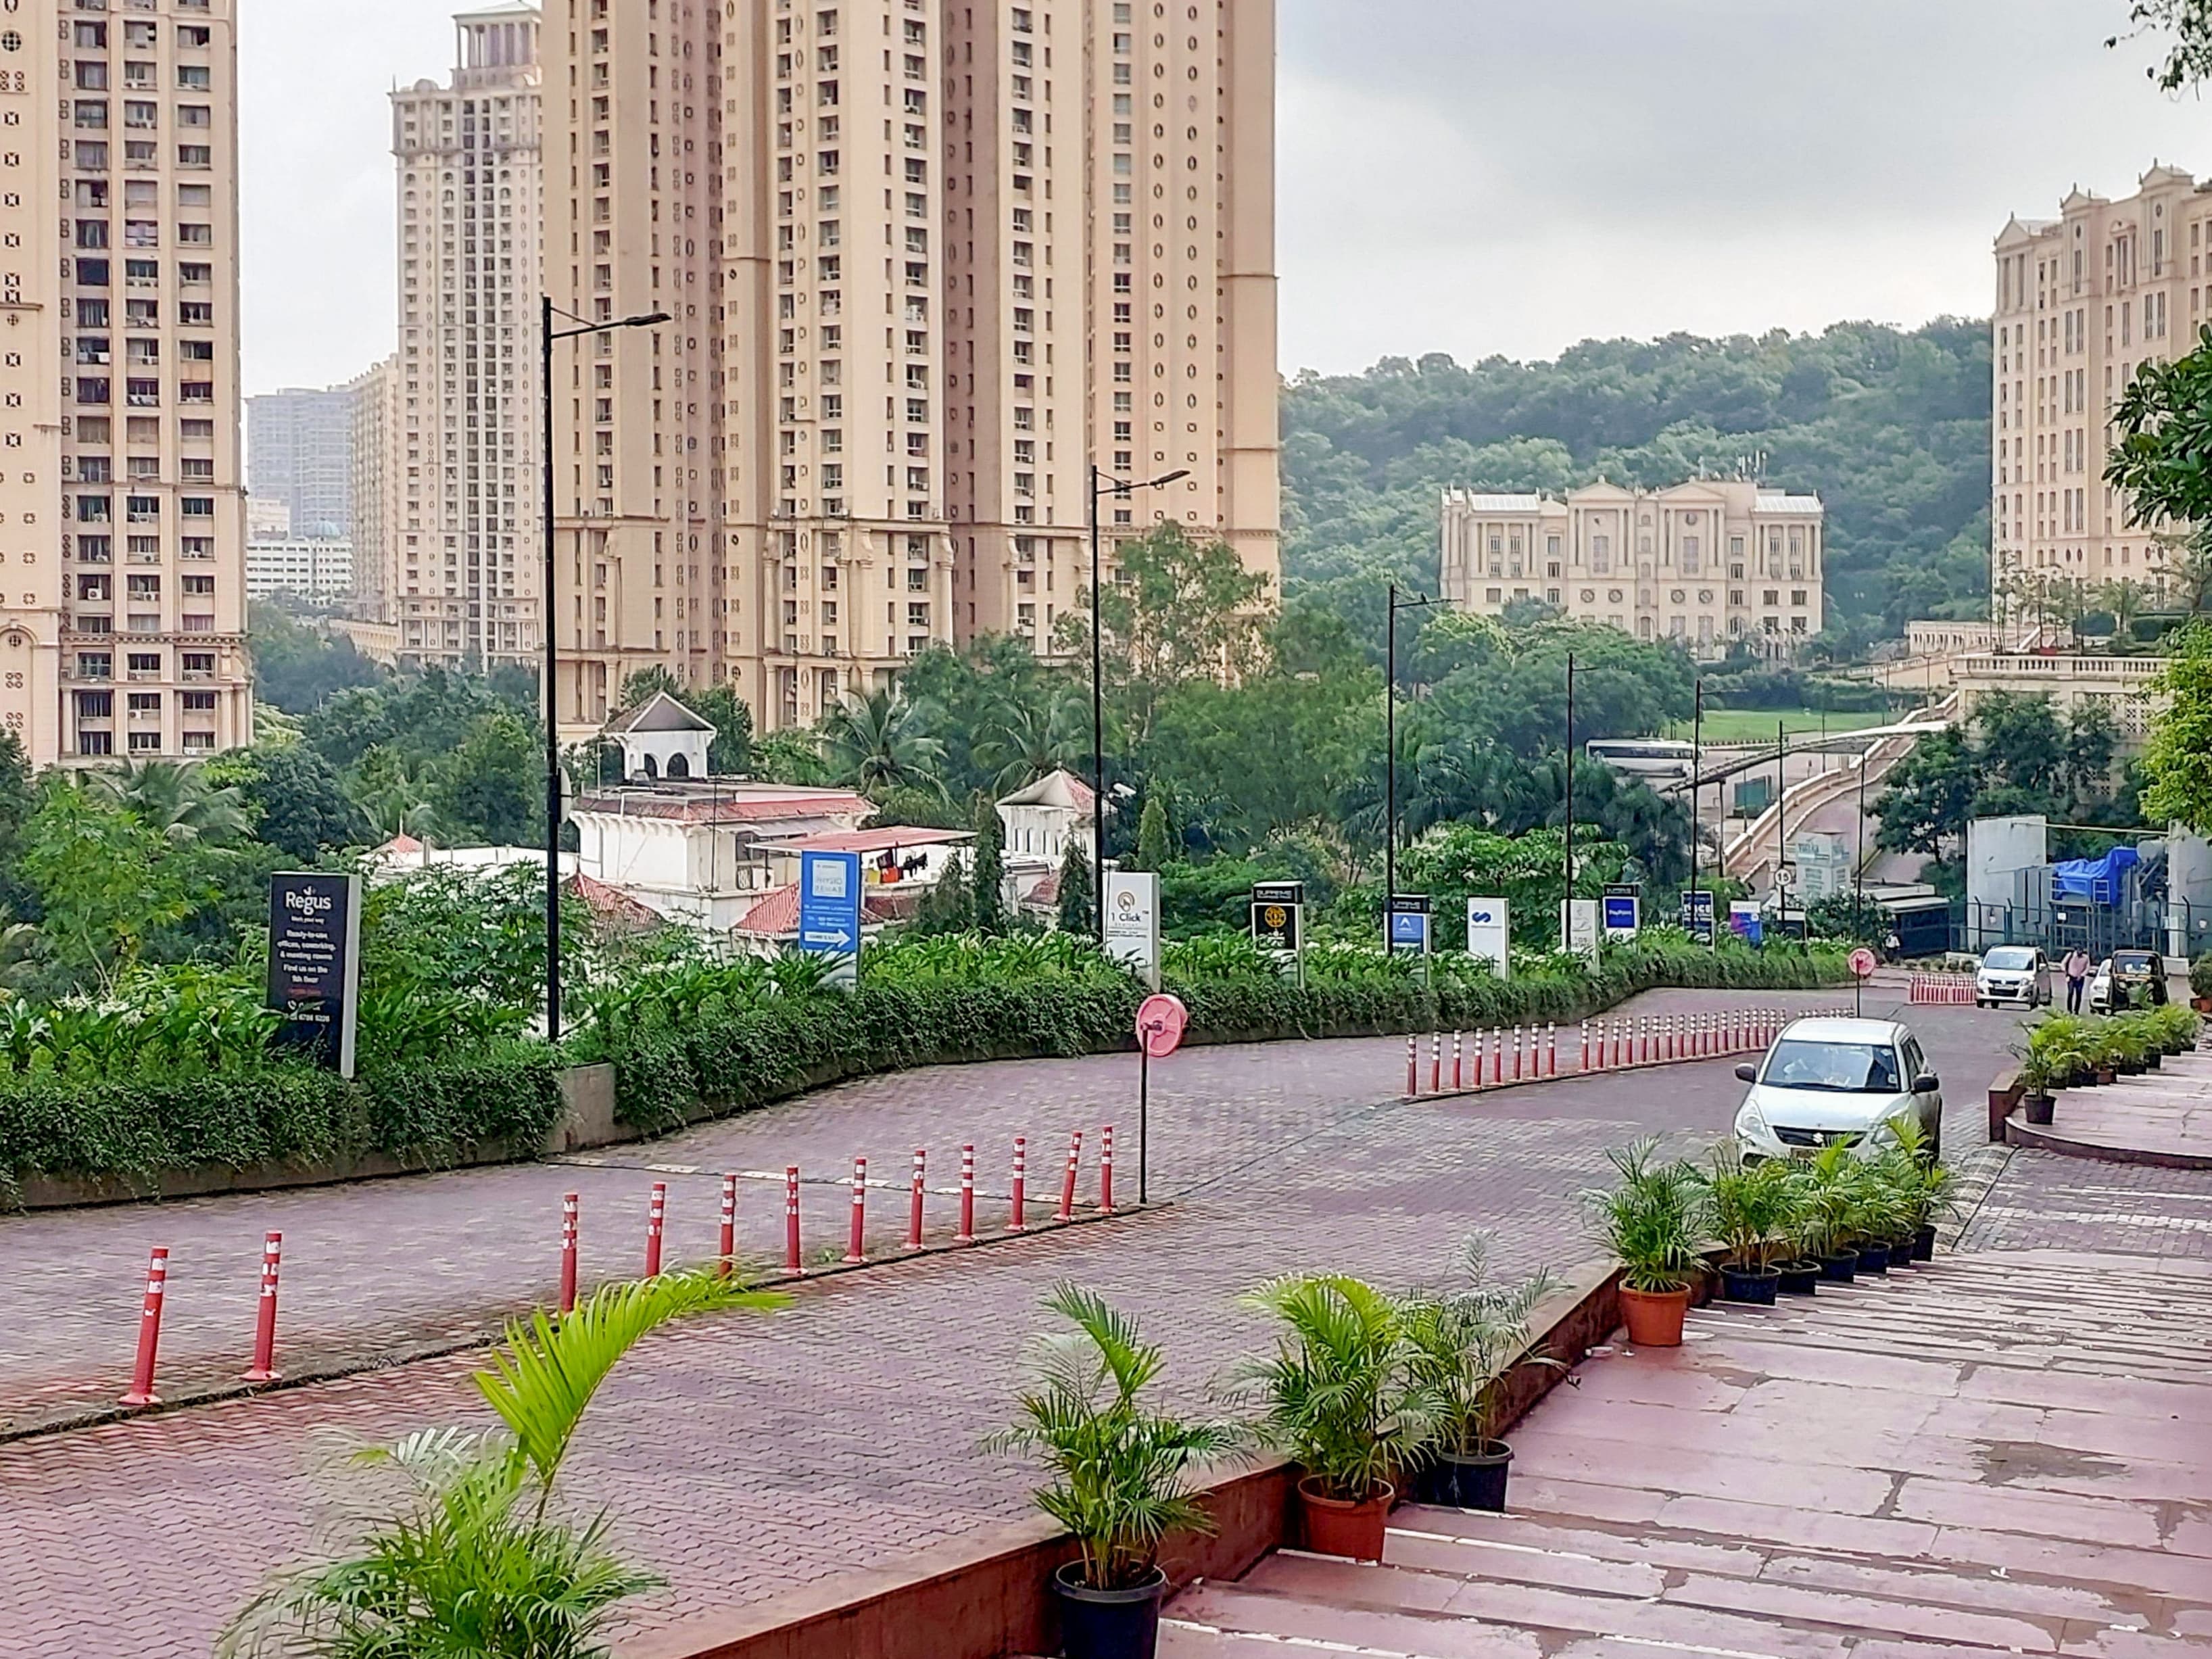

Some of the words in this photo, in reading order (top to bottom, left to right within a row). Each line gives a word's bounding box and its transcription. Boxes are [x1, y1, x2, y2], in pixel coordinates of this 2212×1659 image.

[1777, 871, 1789, 880] 15
[285, 891, 332, 915] Regus
[1119, 913, 1141, 922] Click
[283, 963, 297, 971] Find
[317, 965, 328, 973] the
